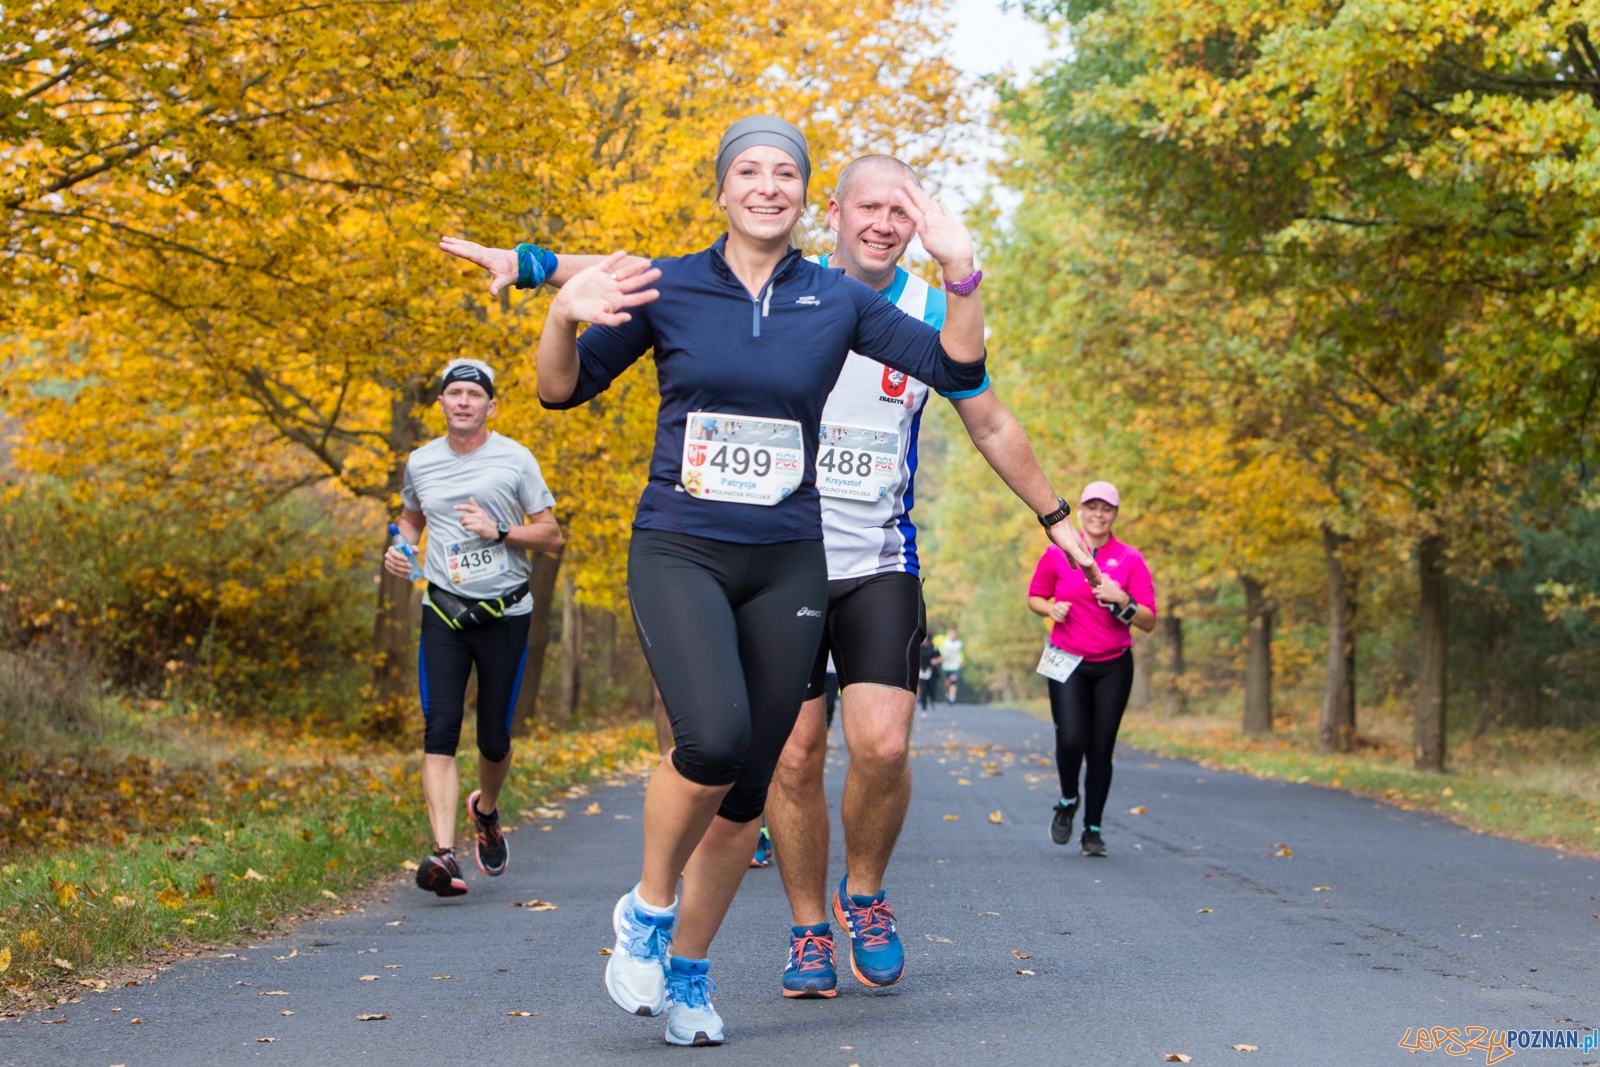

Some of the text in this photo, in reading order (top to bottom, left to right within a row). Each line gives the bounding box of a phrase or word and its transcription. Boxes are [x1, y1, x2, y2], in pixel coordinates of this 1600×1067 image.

[710, 445, 772, 477] 499
[818, 448, 872, 477] 488
[721, 477, 757, 490] Patrycja
[825, 476, 862, 488] Krzysztof
[711, 489, 772, 500] POLINOVA POLSKA
[818, 486, 871, 497] POLINOVA POLSKA
[460, 549, 492, 569] 436
